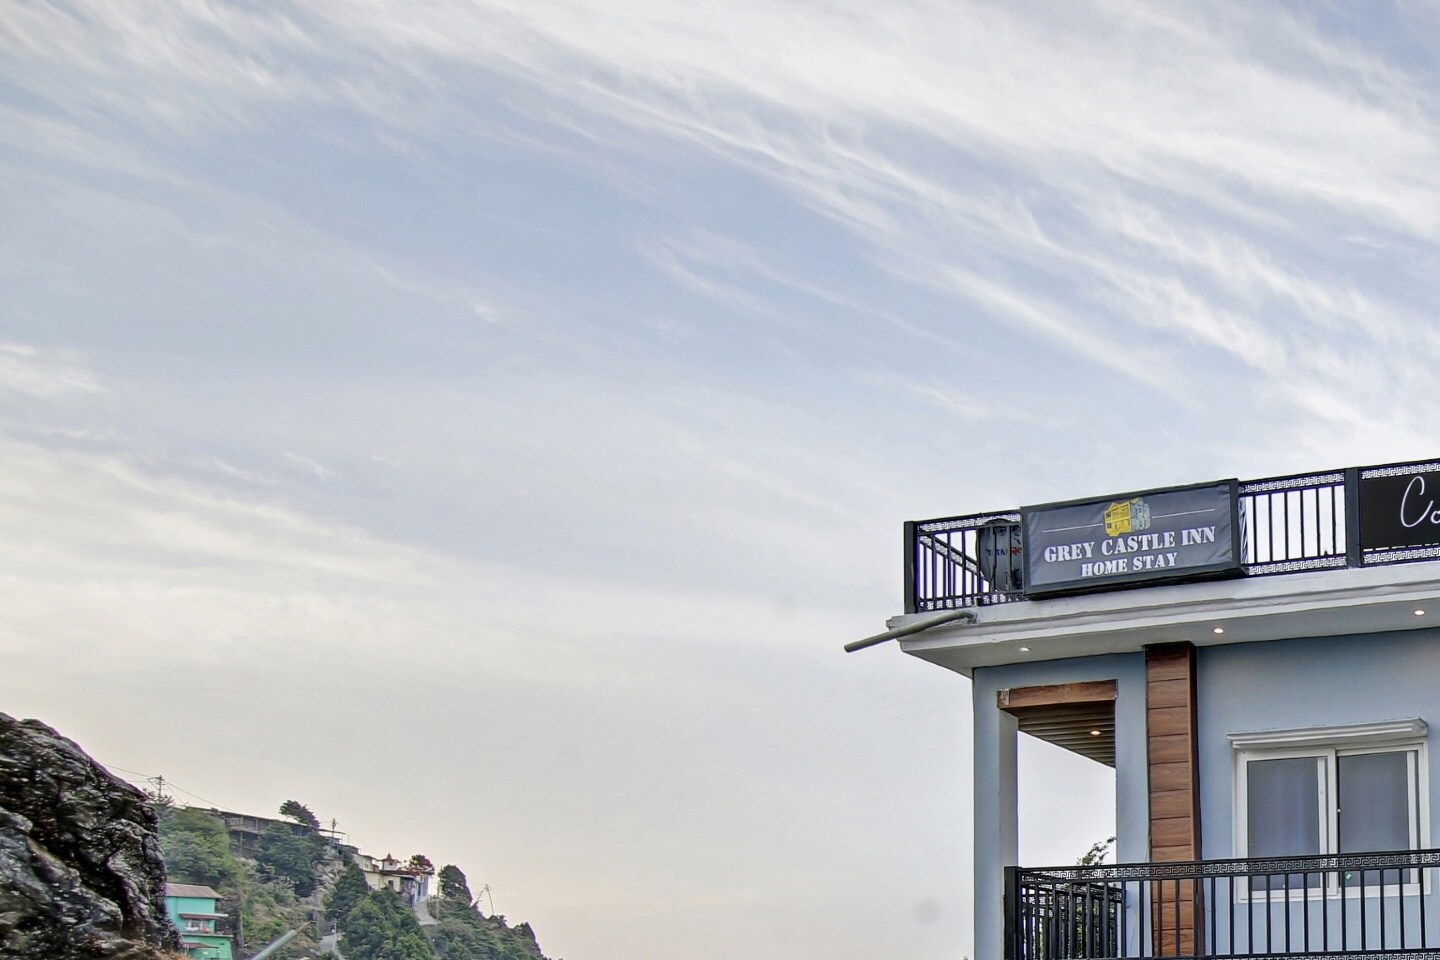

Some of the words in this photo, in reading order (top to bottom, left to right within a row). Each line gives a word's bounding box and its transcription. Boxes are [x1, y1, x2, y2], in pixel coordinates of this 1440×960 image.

[1044, 541, 1095, 563] GREY
[1101, 531, 1176, 556] CASTLE
[1181, 526, 1216, 546] INN
[1081, 558, 1128, 577] HOME
[1132, 552, 1178, 571] STAY
